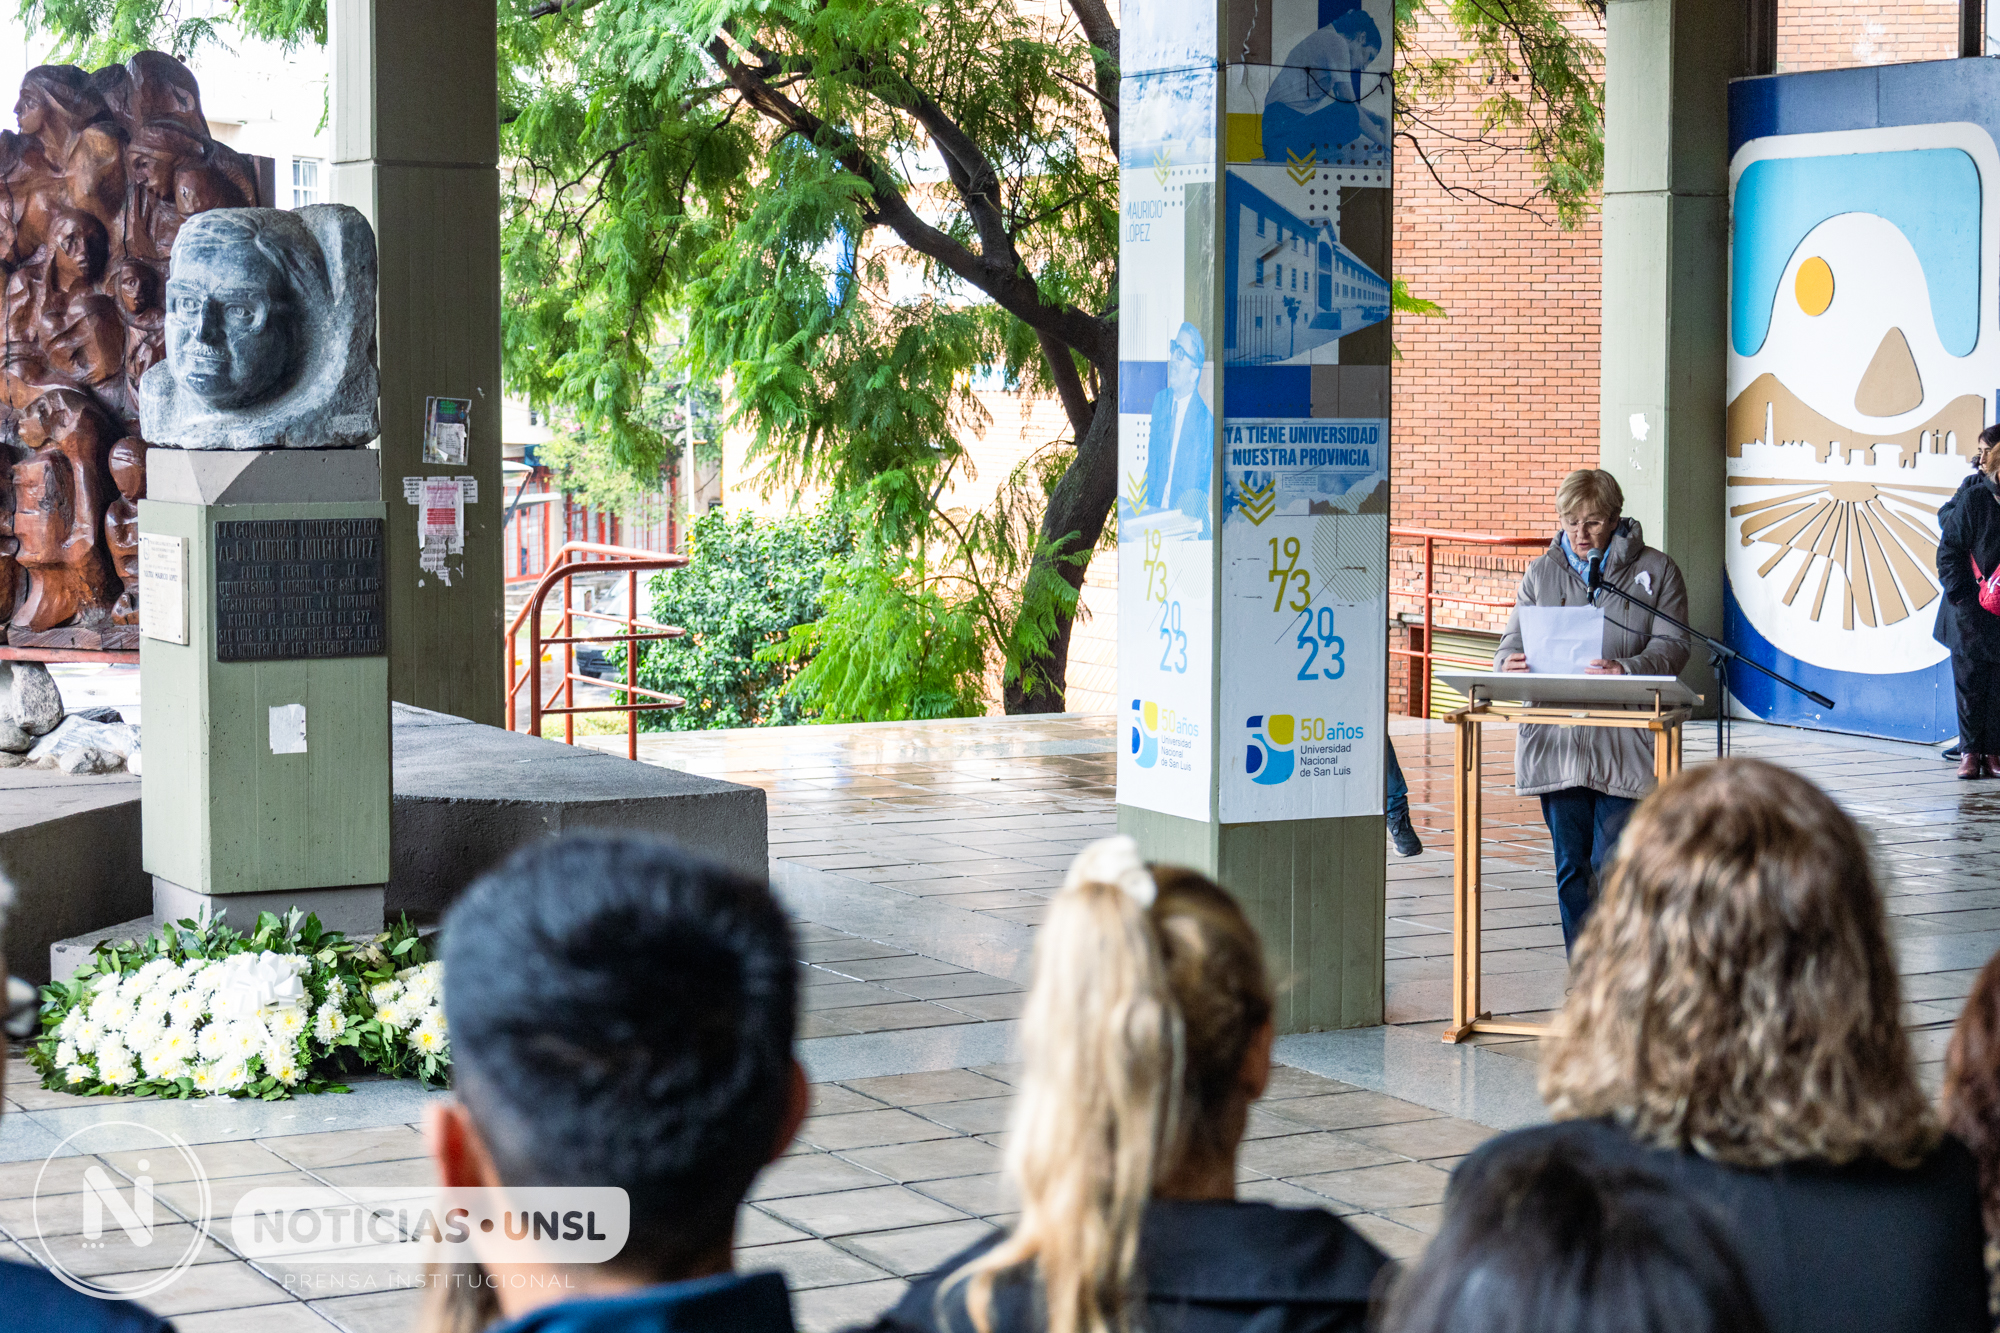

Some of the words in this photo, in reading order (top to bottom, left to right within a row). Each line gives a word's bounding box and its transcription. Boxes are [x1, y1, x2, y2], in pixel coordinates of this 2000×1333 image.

[1125, 200, 1162, 219] MAURICIO
[1126, 220, 1150, 242] LÓPEZ
[1226, 426, 1242, 444] YA
[1246, 426, 1285, 443] TIENE
[1289, 426, 1378, 444] UNIVERSIDAD
[1232, 449, 1297, 466] NUESTRA
[1301, 449, 1370, 466] PROVINCIA
[217, 522, 231, 538] LA
[235, 521, 296, 538] COMUNIDAD
[301, 520, 381, 537] UNIVERSITARIA
[252, 540, 296, 560] MAURICIO
[300, 539, 340, 560] AMILCAR
[345, 538, 375, 559] LOPEZ
[1144, 528, 1161, 563] 19
[1269, 537, 1300, 572] 19
[281, 564, 312, 578] RECTOR
[323, 564, 334, 576] DE
[348, 564, 358, 576] LA
[219, 581, 277, 596] UNIVERSIDAD
[281, 580, 320, 593] NACIONAL
[325, 579, 336, 592] DE
[339, 578, 356, 592] SAN
[361, 578, 380, 591] LUIS
[1144, 560, 1168, 603] 73
[1269, 569, 1311, 612] 73
[1160, 600, 1181, 634] 20
[1297, 607, 1334, 641] 20
[1160, 628, 1187, 674] 23
[1297, 636, 1345, 681] 23
[1162, 708, 1175, 732] 50
[1177, 717, 1199, 737] años
[1301, 718, 1325, 741] 50
[1327, 722, 1364, 740] años
[1161, 735, 1191, 749] Universidad
[1161, 746, 1183, 758] Nacional
[1300, 743, 1351, 754] Universidad
[1161, 758, 1167, 767] de
[1169, 758, 1179, 768] San
[1181, 761, 1191, 771] Luis
[1300, 756, 1338, 765] Nacional
[1300, 768, 1311, 777] de
[1313, 767, 1330, 776] San
[1333, 766, 1351, 775] Luis
